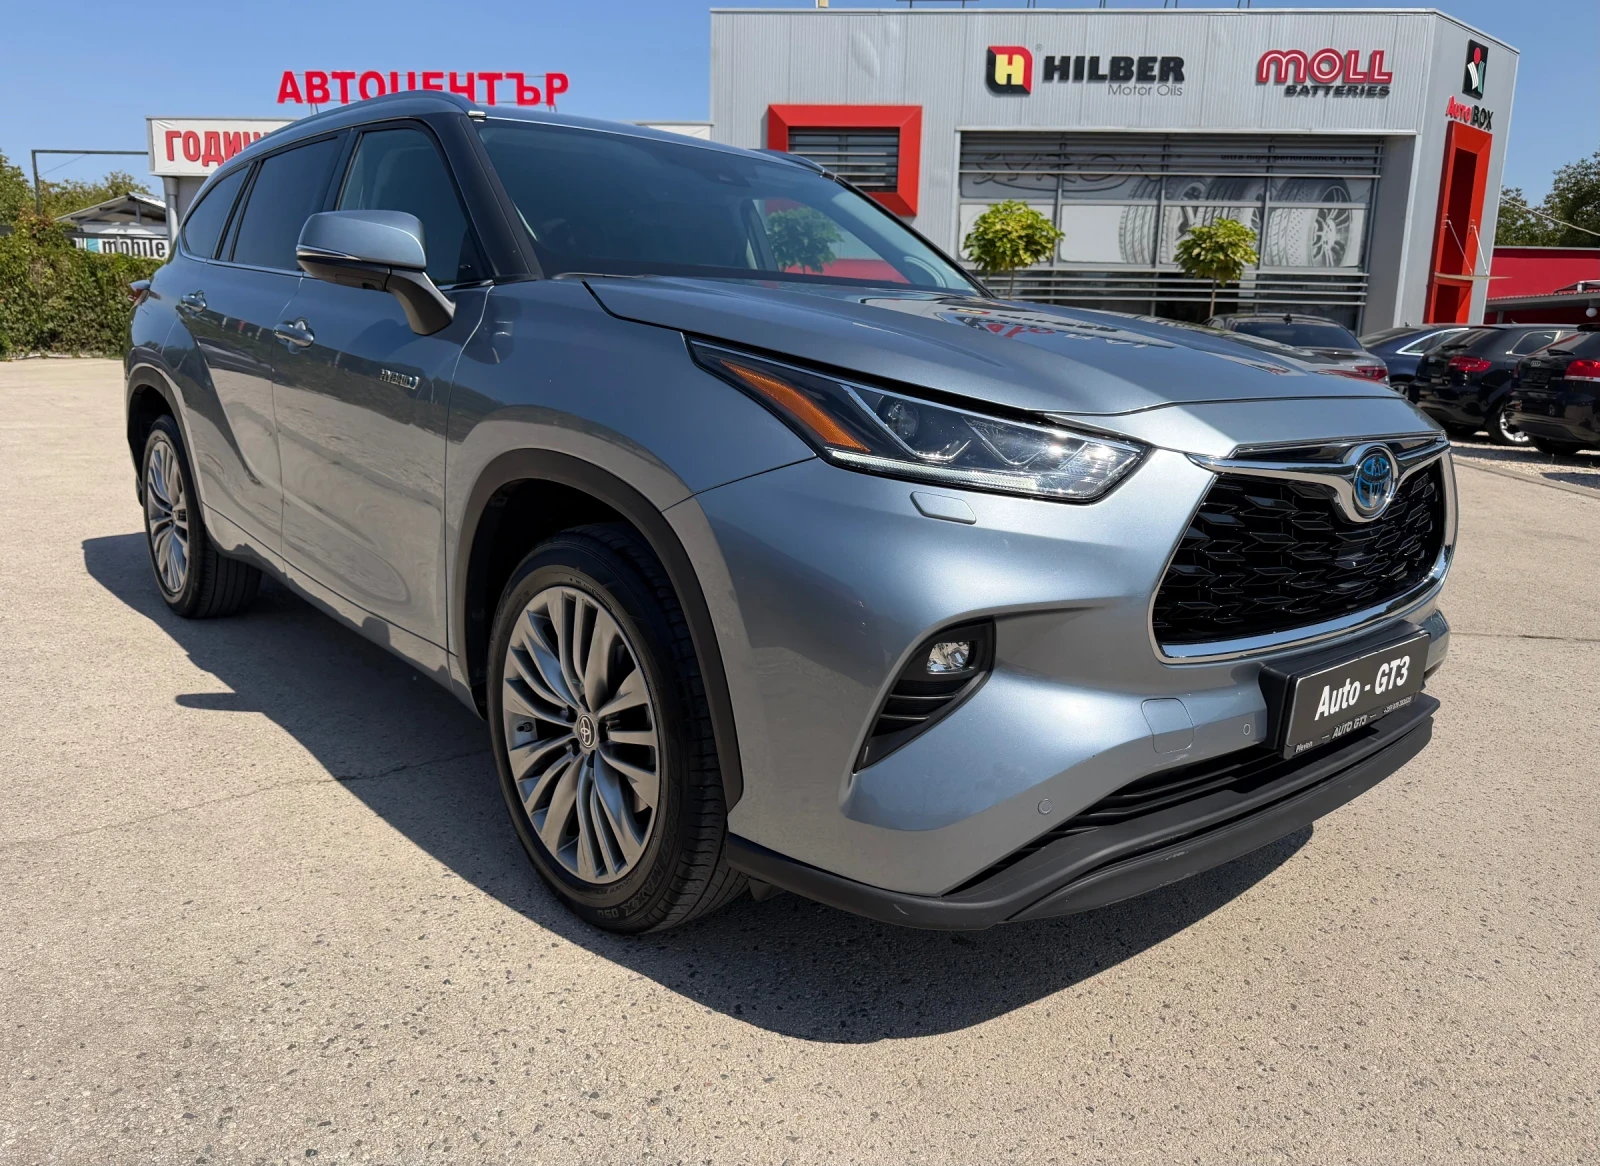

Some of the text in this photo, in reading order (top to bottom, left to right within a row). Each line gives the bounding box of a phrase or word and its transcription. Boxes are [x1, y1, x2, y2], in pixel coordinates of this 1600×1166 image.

[1043, 55, 1185, 83] HILBER
[1257, 48, 1393, 83] MOLL
[1108, 84, 1183, 96] Motor Oils
[1285, 85, 1390, 97] BATTERIES
[1314, 677, 1360, 721] Auto
[1374, 655, 1411, 695] GT3
[1332, 720, 1353, 739] AUTO
[1353, 714, 1368, 729] GT3
